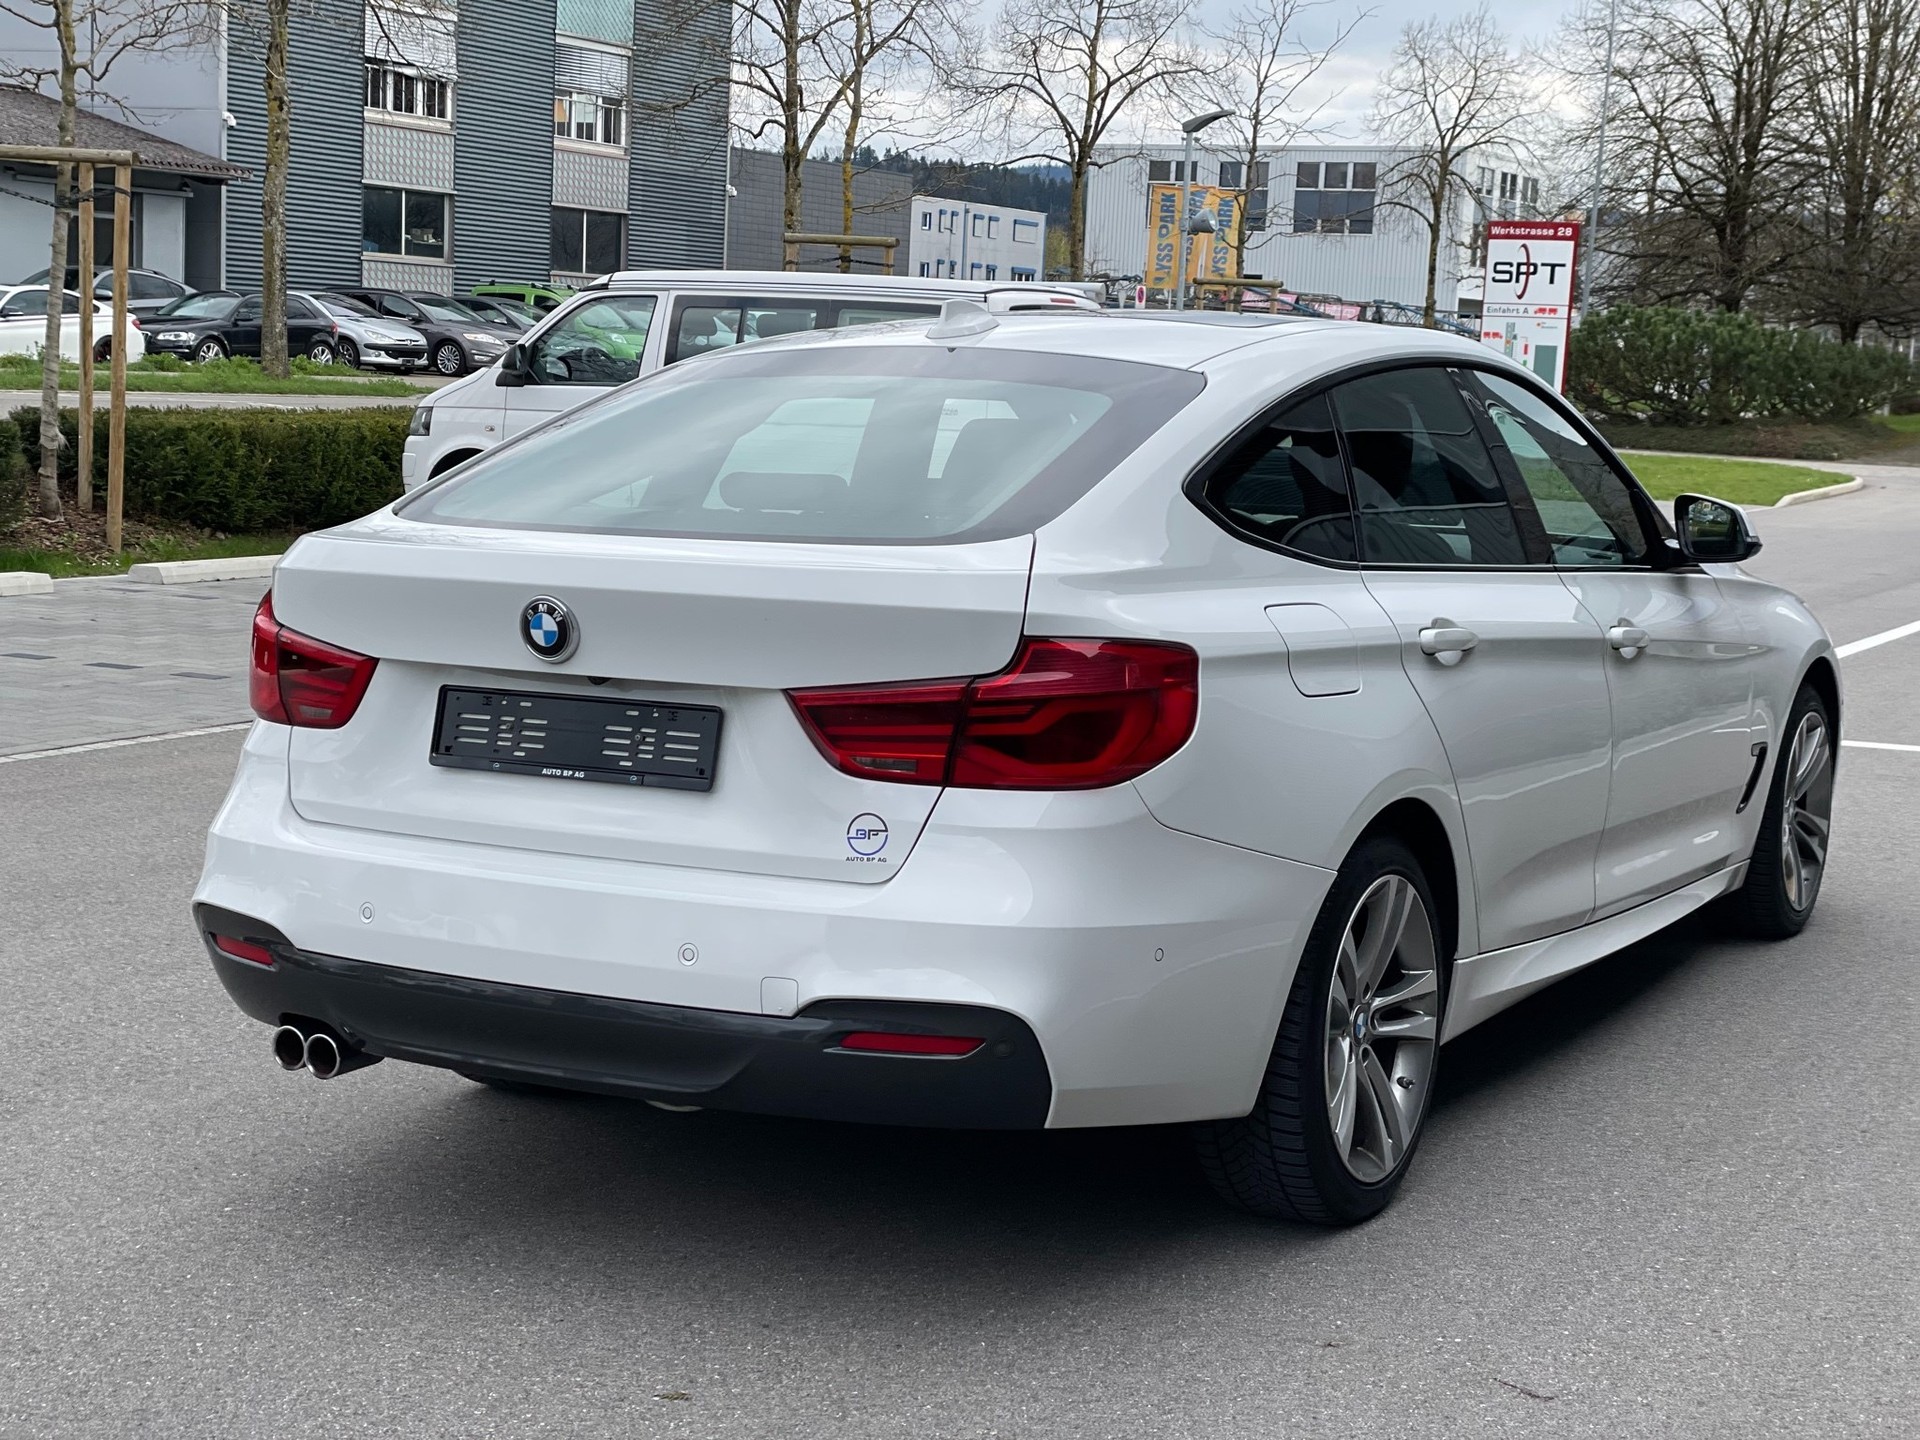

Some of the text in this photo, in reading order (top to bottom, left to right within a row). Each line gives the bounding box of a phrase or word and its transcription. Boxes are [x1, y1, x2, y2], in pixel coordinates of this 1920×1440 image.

[1211, 198, 1235, 277] YSSPARK
[1491, 226, 1573, 236] Werkstrasse 28
[1491, 261, 1566, 285] SPT
[1486, 306, 1520, 314] Einfahrt
[526, 603, 563, 623] BMW
[541, 768, 562, 776] AUTO
